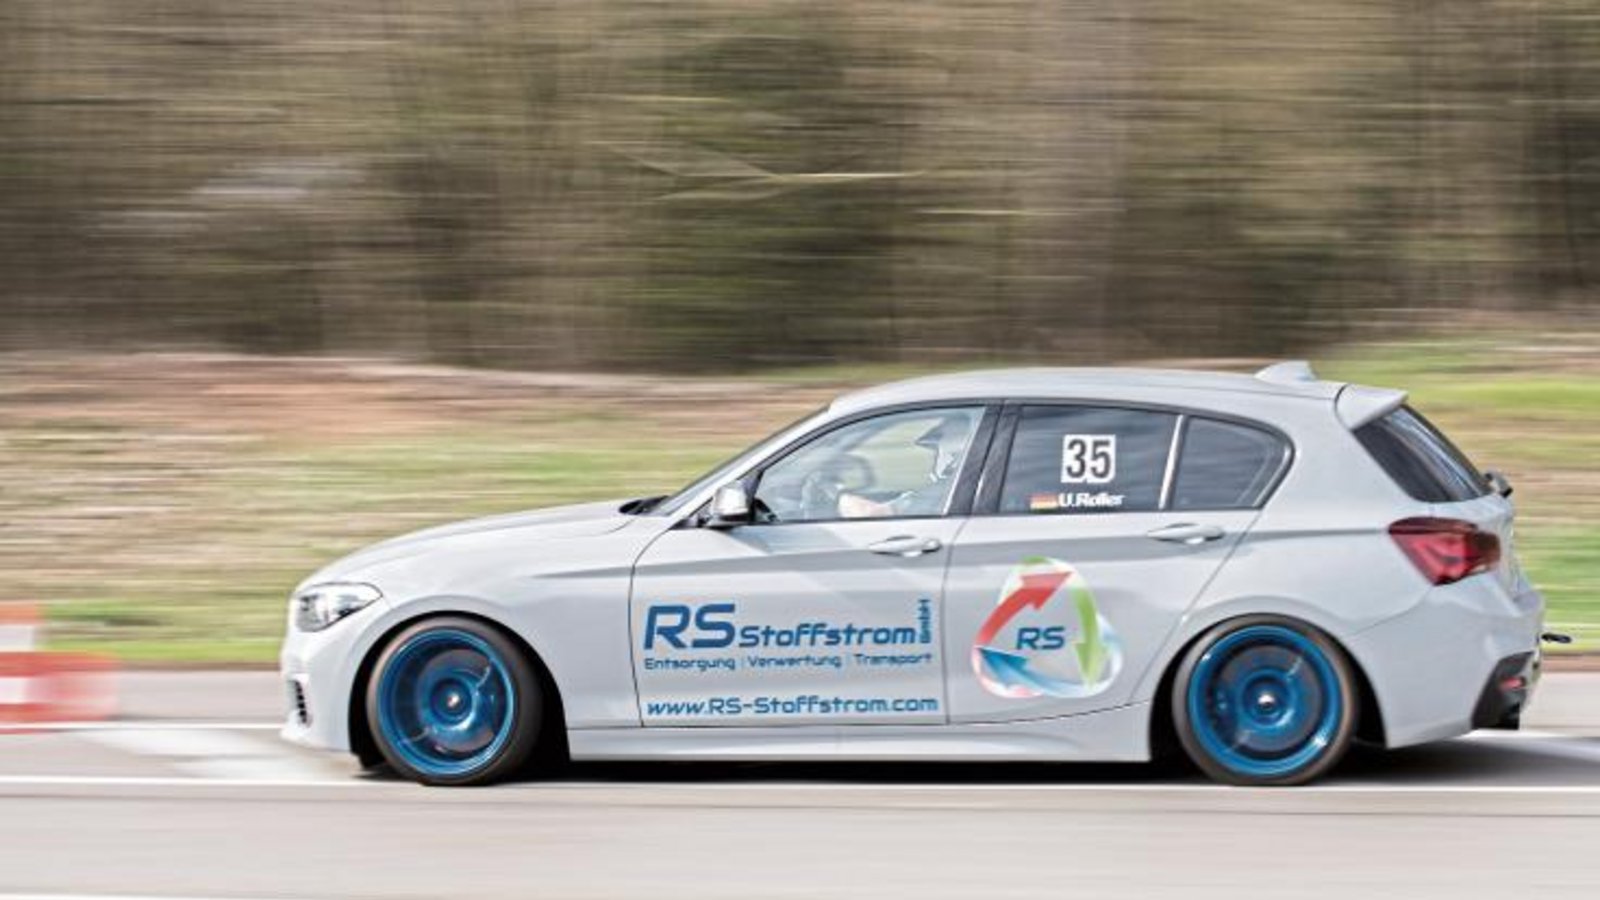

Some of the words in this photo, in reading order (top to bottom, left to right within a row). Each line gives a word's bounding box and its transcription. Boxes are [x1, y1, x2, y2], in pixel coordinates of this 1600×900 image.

[1066, 438, 1111, 479] 35
[644, 603, 735, 649] RS
[738, 622, 916, 648] Stoffstrom
[1016, 626, 1065, 650] RS
[644, 658, 735, 671] Entsorgung
[747, 655, 841, 668] Verwertung
[854, 653, 932, 666] Transport
[647, 696, 938, 715] www.RS-Stoffstrom.com
